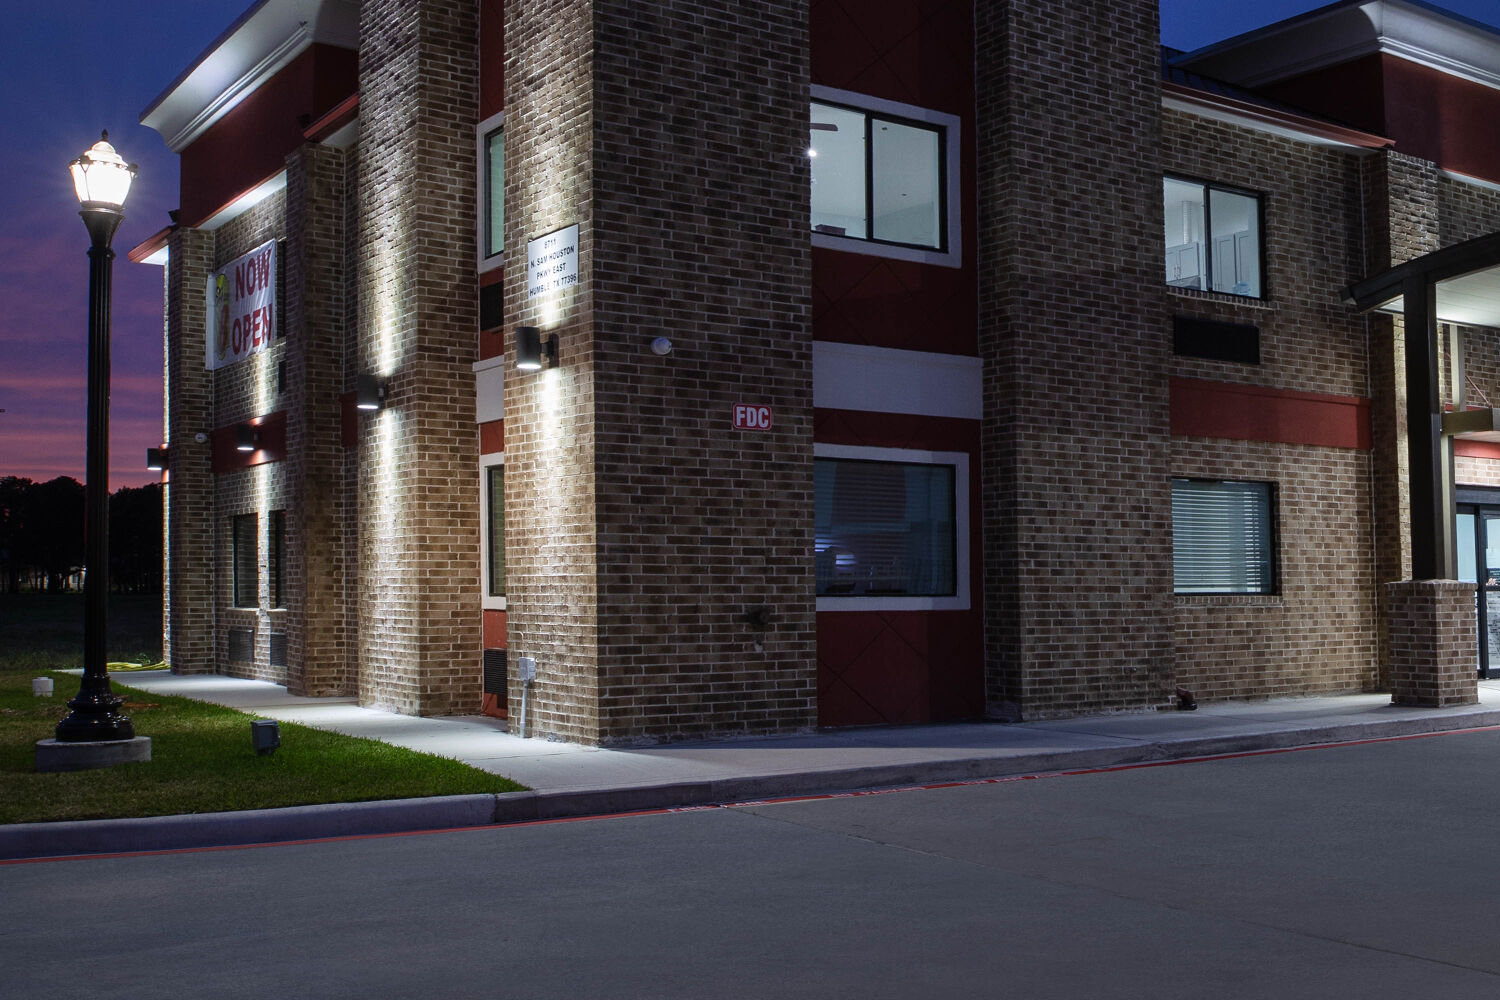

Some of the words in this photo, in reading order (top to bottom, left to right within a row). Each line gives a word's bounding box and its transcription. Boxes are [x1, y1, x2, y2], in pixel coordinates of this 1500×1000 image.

[536, 255, 548, 266] SAM
[549, 245, 575, 260] HOUSTON
[235, 248, 272, 301] NOW
[552, 262, 567, 274] EAST
[232, 302, 273, 355] OPEN
[736, 406, 769, 428] FDC
